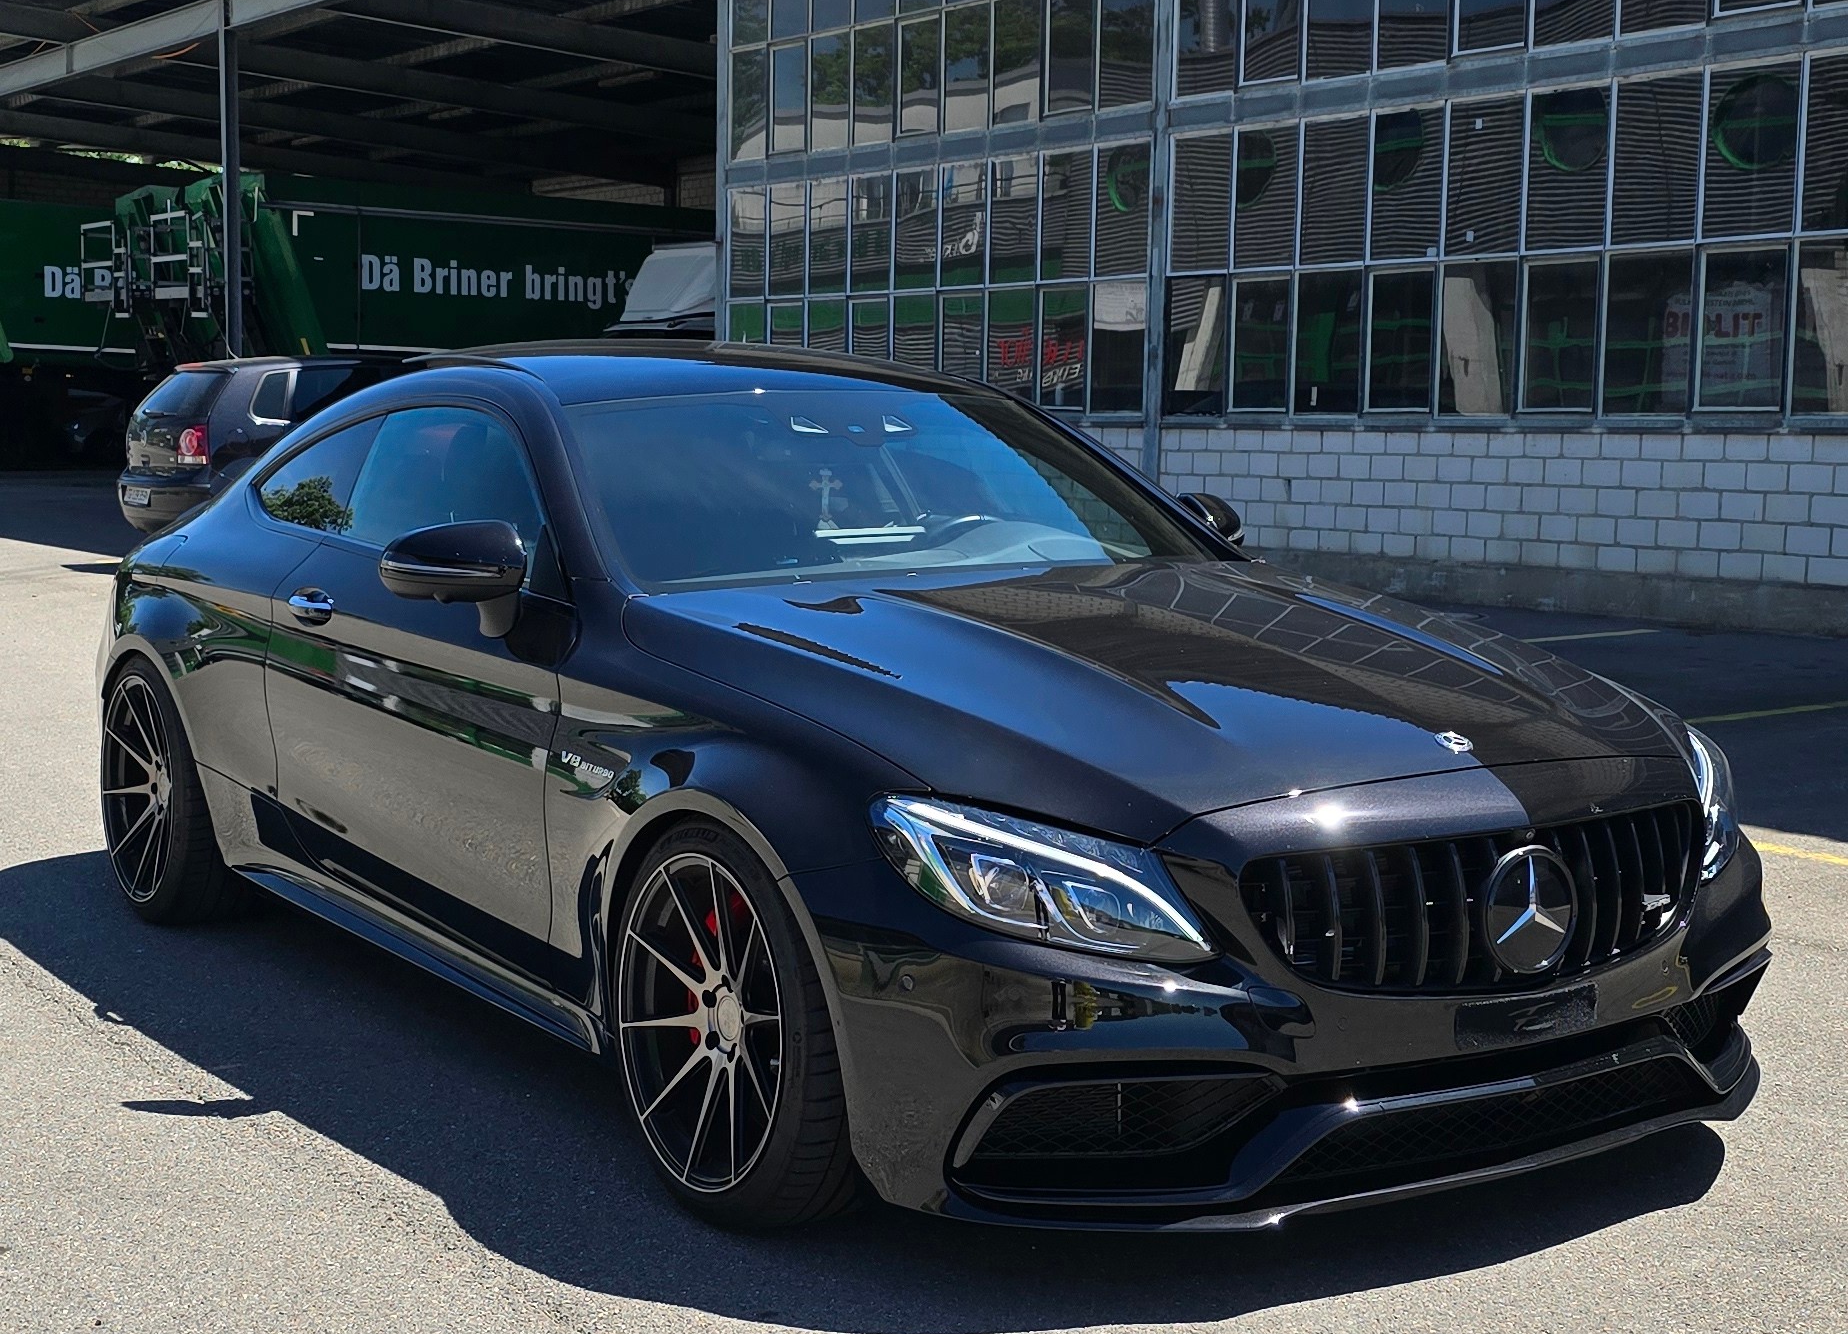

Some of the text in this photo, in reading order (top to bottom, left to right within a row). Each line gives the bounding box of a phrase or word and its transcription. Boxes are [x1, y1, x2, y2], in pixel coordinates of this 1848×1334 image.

[44, 265, 81, 299] Dä
[361, 254, 400, 292] Dä
[413, 257, 513, 298] Briner
[561, 750, 581, 767] V8
